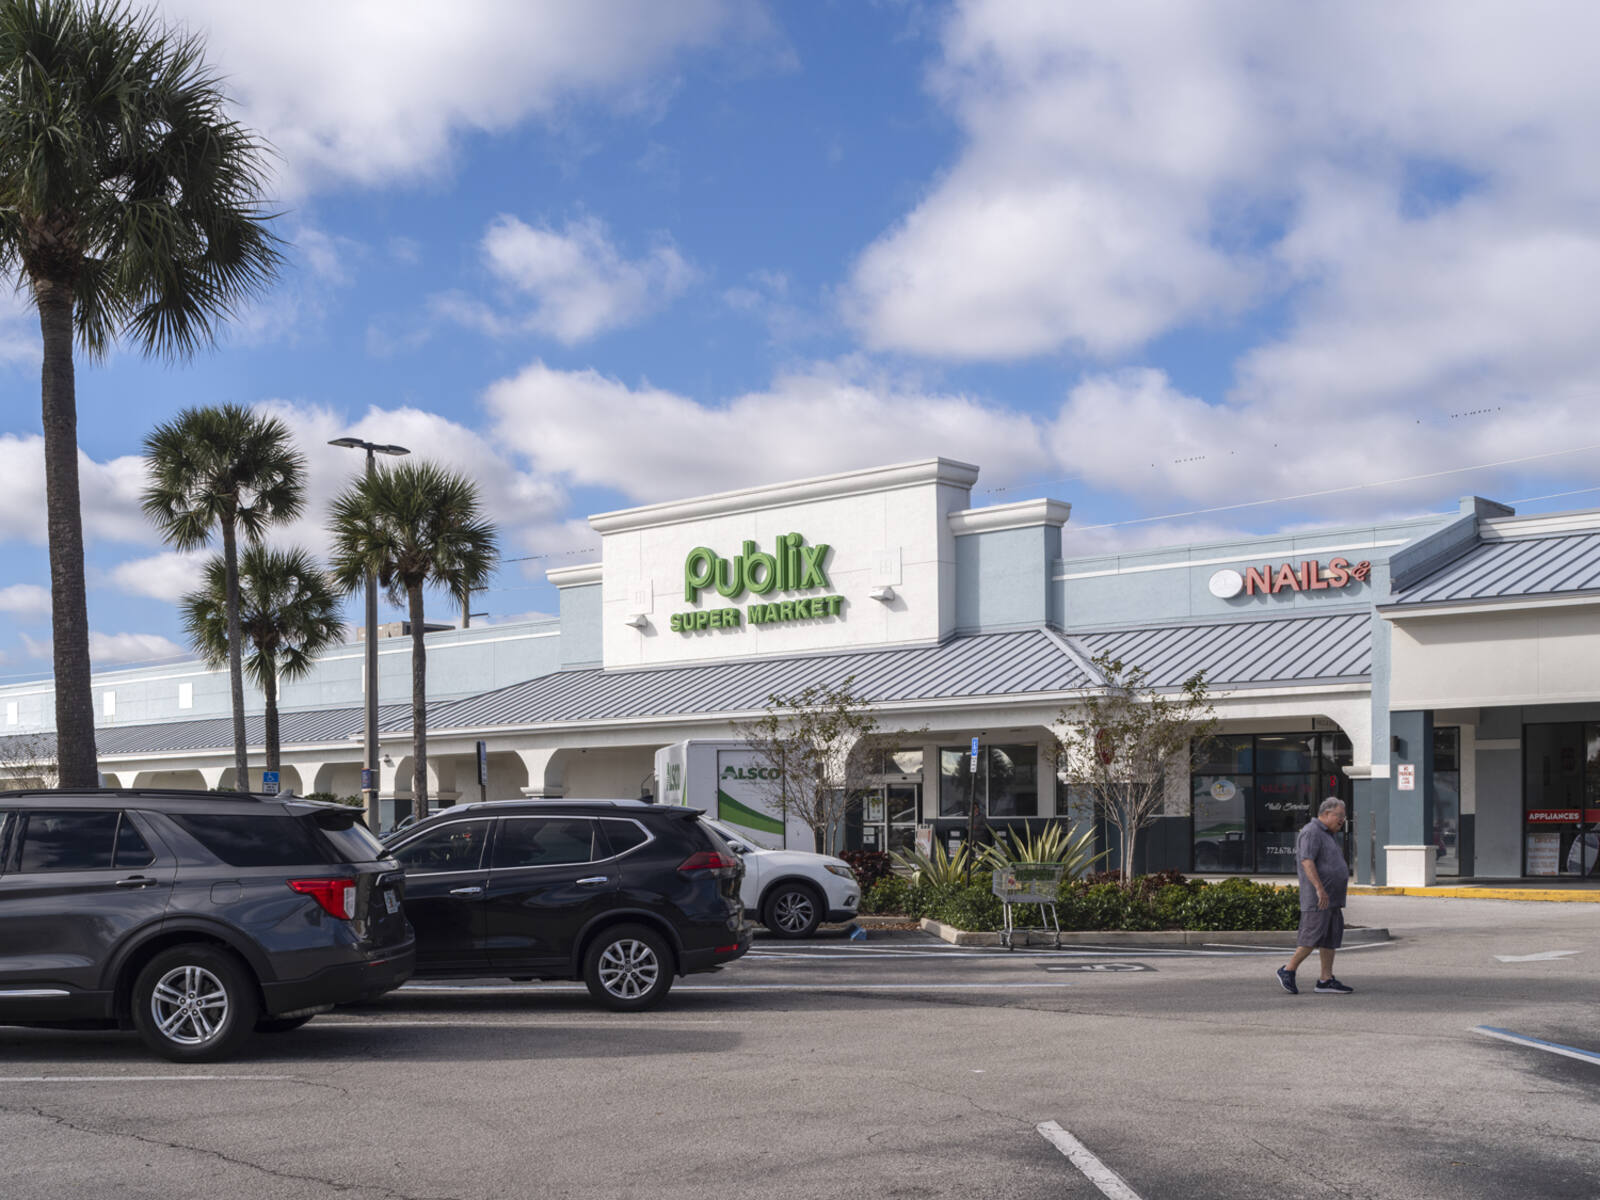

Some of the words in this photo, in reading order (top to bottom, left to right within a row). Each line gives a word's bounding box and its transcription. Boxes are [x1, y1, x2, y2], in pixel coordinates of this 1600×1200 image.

[684, 532, 829, 603] Publix
[1246, 557, 1349, 596] NAILS
[1351, 560, 1371, 581] &
[670, 608, 741, 632] SUPER
[747, 595, 845, 625] MARKET
[721, 765, 781, 780] ALSCO
[1528, 812, 1580, 821] APPLIANCES
